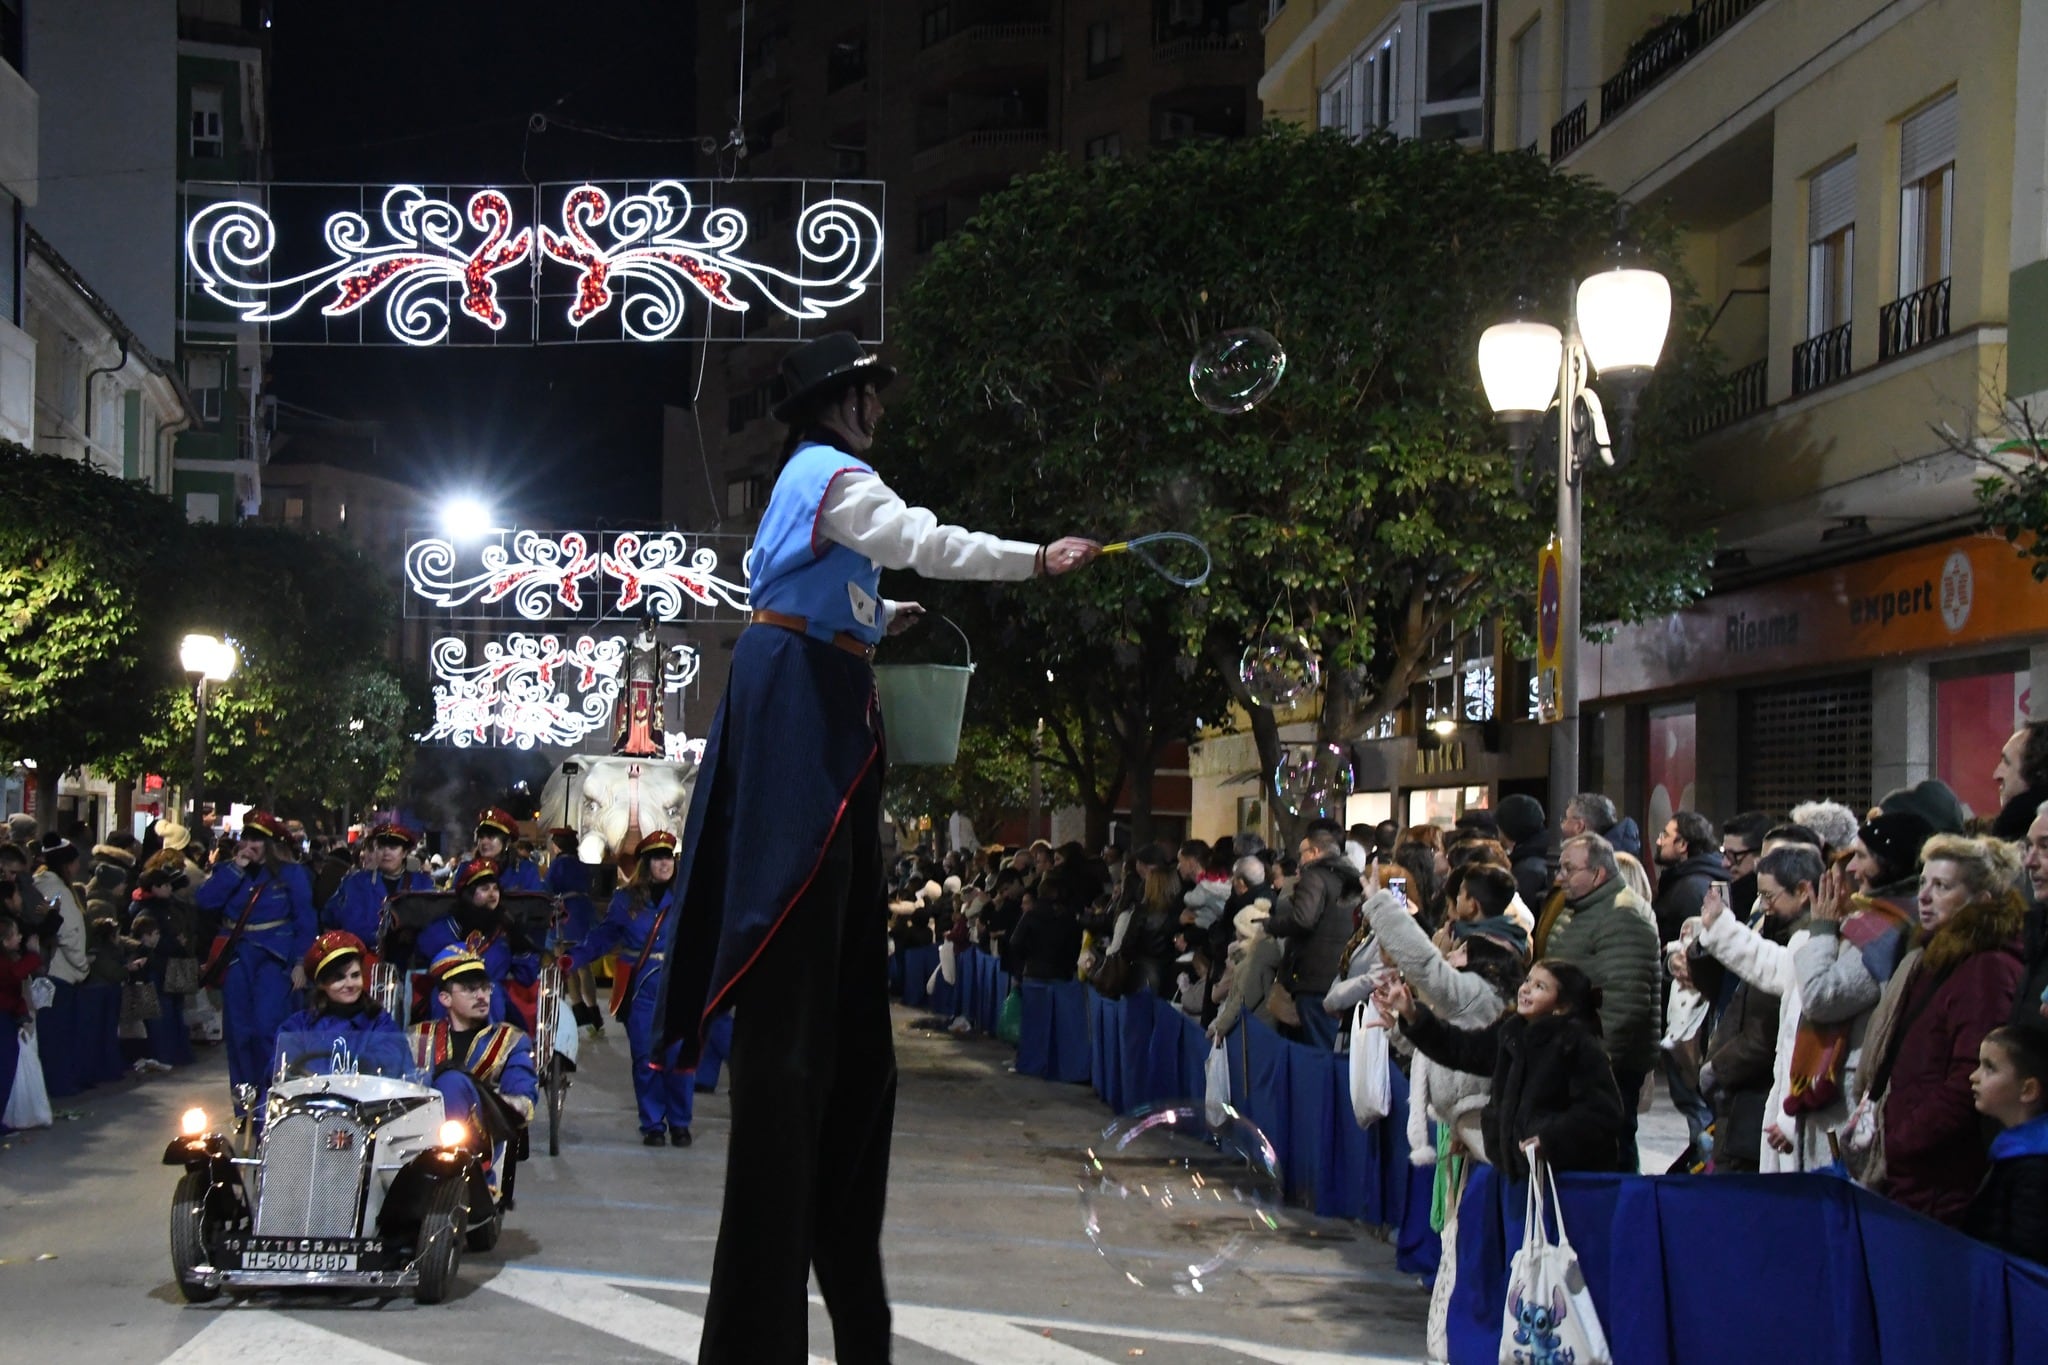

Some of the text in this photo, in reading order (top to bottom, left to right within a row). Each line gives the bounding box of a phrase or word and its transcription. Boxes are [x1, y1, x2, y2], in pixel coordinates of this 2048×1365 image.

[1726, 580, 1932, 651] Riesma expert
[247, 1240, 361, 1252] RYTECRAFT
